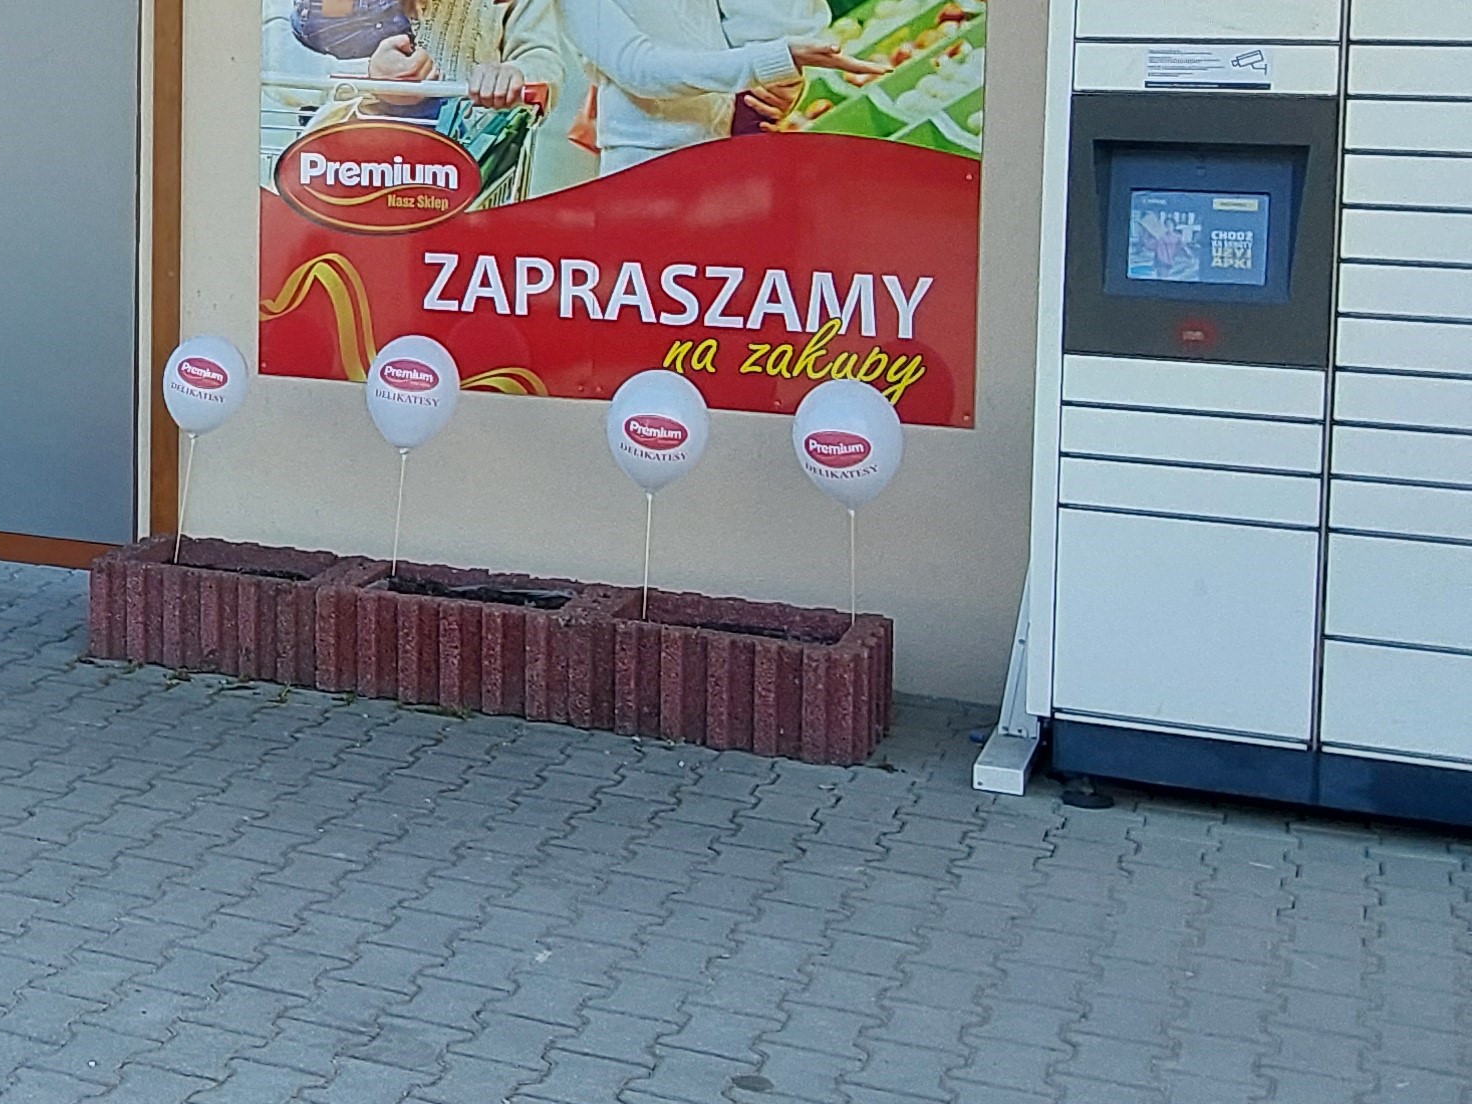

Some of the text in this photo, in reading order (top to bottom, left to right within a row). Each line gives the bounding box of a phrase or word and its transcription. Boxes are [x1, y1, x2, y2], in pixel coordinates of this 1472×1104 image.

[300, 152, 458, 190] Premium
[388, 194, 449, 211] Nasz Sklep
[423, 252, 934, 339] ZAPRASZAMY
[663, 318, 926, 405] na zakupy
[180, 361, 224, 383] Premium
[384, 365, 434, 383] Premium
[170, 381, 225, 403] DELIKATESY
[375, 388, 440, 408] DELIKATESY
[629, 421, 682, 439] Premium
[620, 442, 688, 462] DELIKATESY
[809, 438, 864, 455] Premium
[805, 462, 879, 480] DELIKATESY
